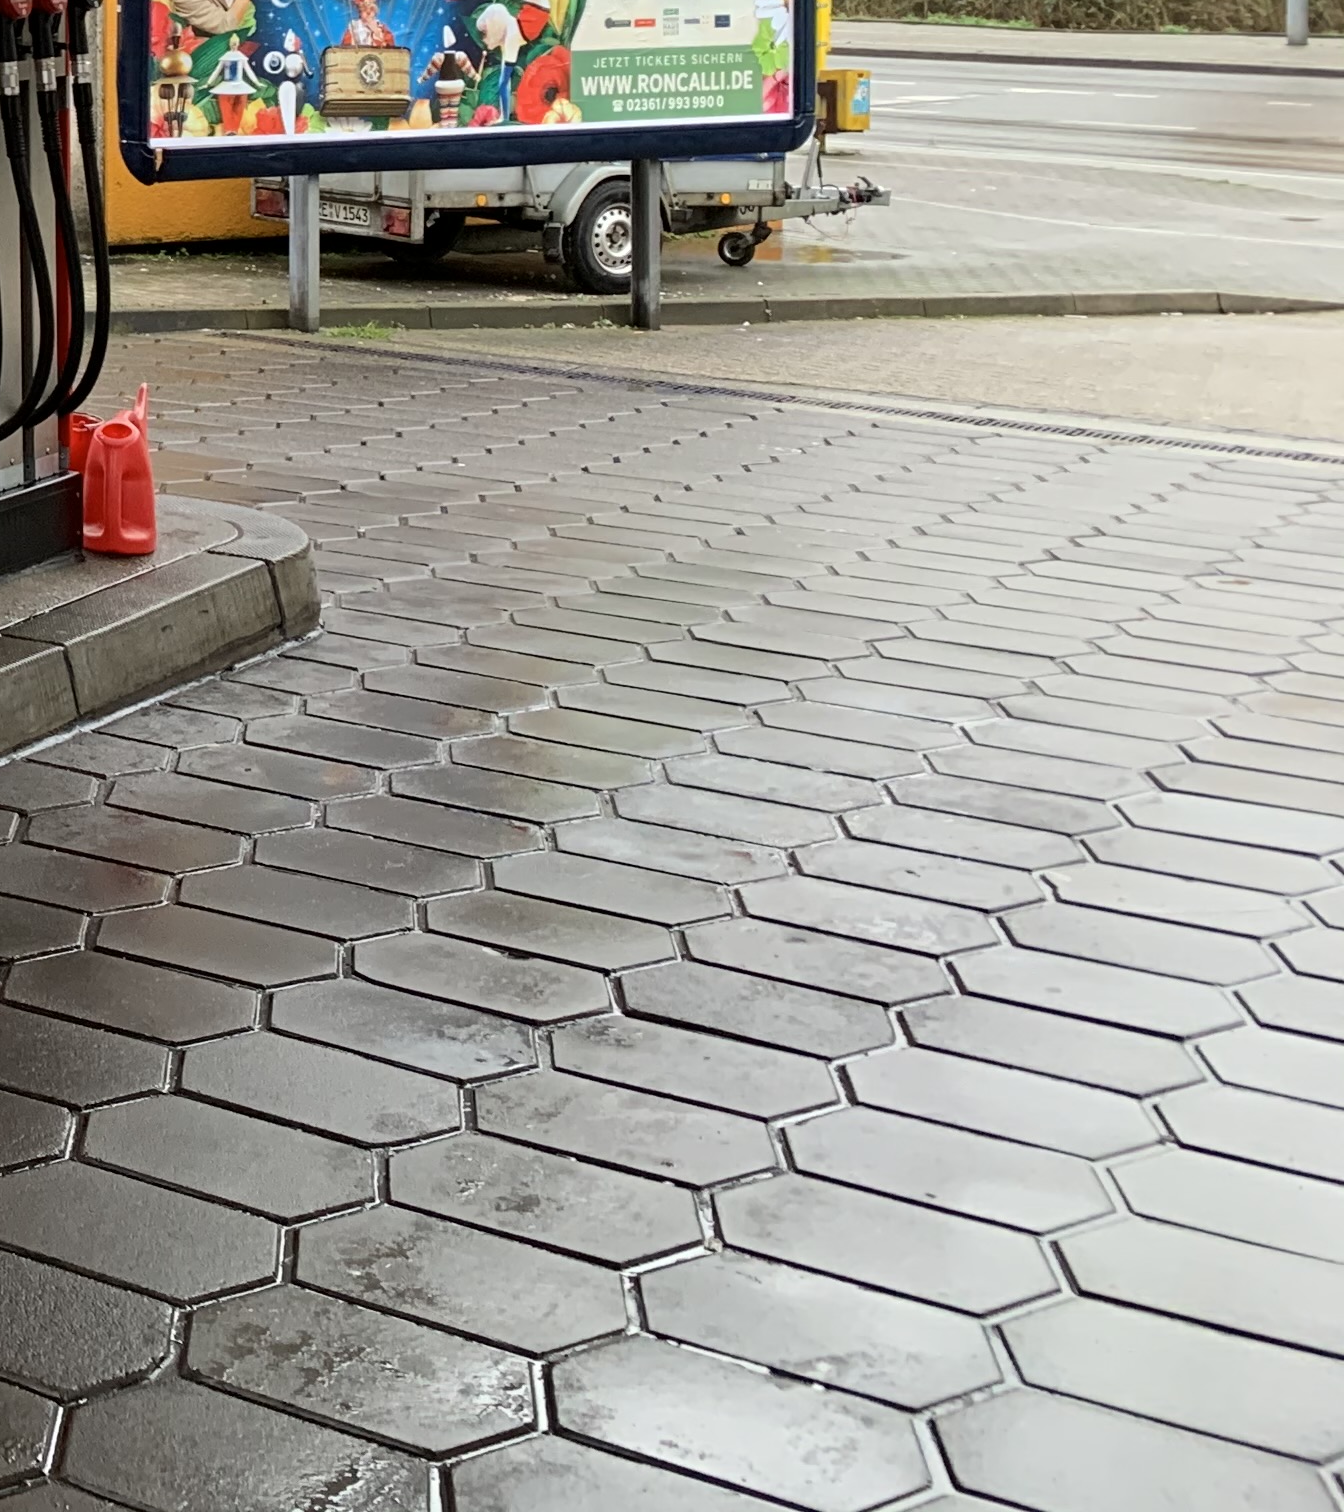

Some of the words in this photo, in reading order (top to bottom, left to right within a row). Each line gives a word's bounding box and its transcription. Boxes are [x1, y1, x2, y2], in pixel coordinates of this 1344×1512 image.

[593, 56, 630, 68] JETZT
[635, 54, 686, 67] TICKETS
[691, 53, 743, 65] SICHERN
[581, 70, 753, 96] WWW.RONCALLI.DE
